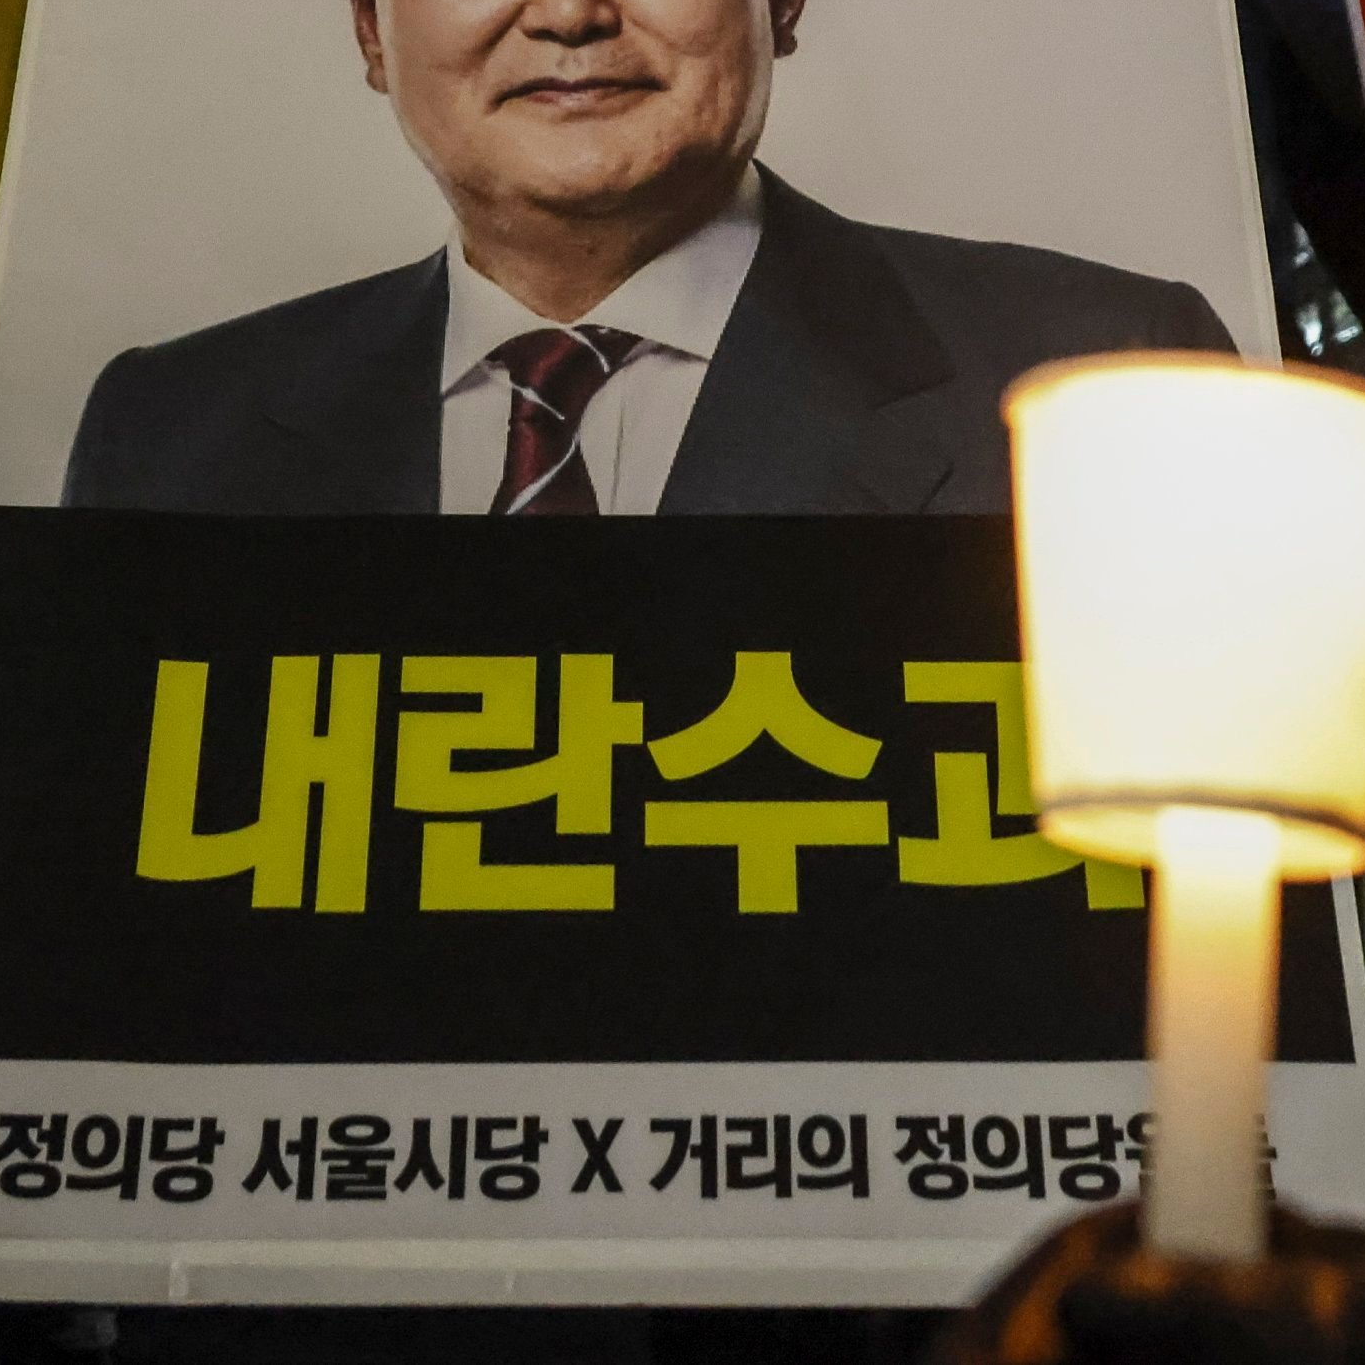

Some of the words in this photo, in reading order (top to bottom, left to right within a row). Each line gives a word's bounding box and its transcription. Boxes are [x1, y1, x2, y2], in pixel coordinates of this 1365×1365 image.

[241, 1113, 550, 1202] 서울시당
[570, 1118, 625, 1194] X
[649, 1114, 871, 1200] 거리의
[894, 1113, 1278, 1203] 정의당
